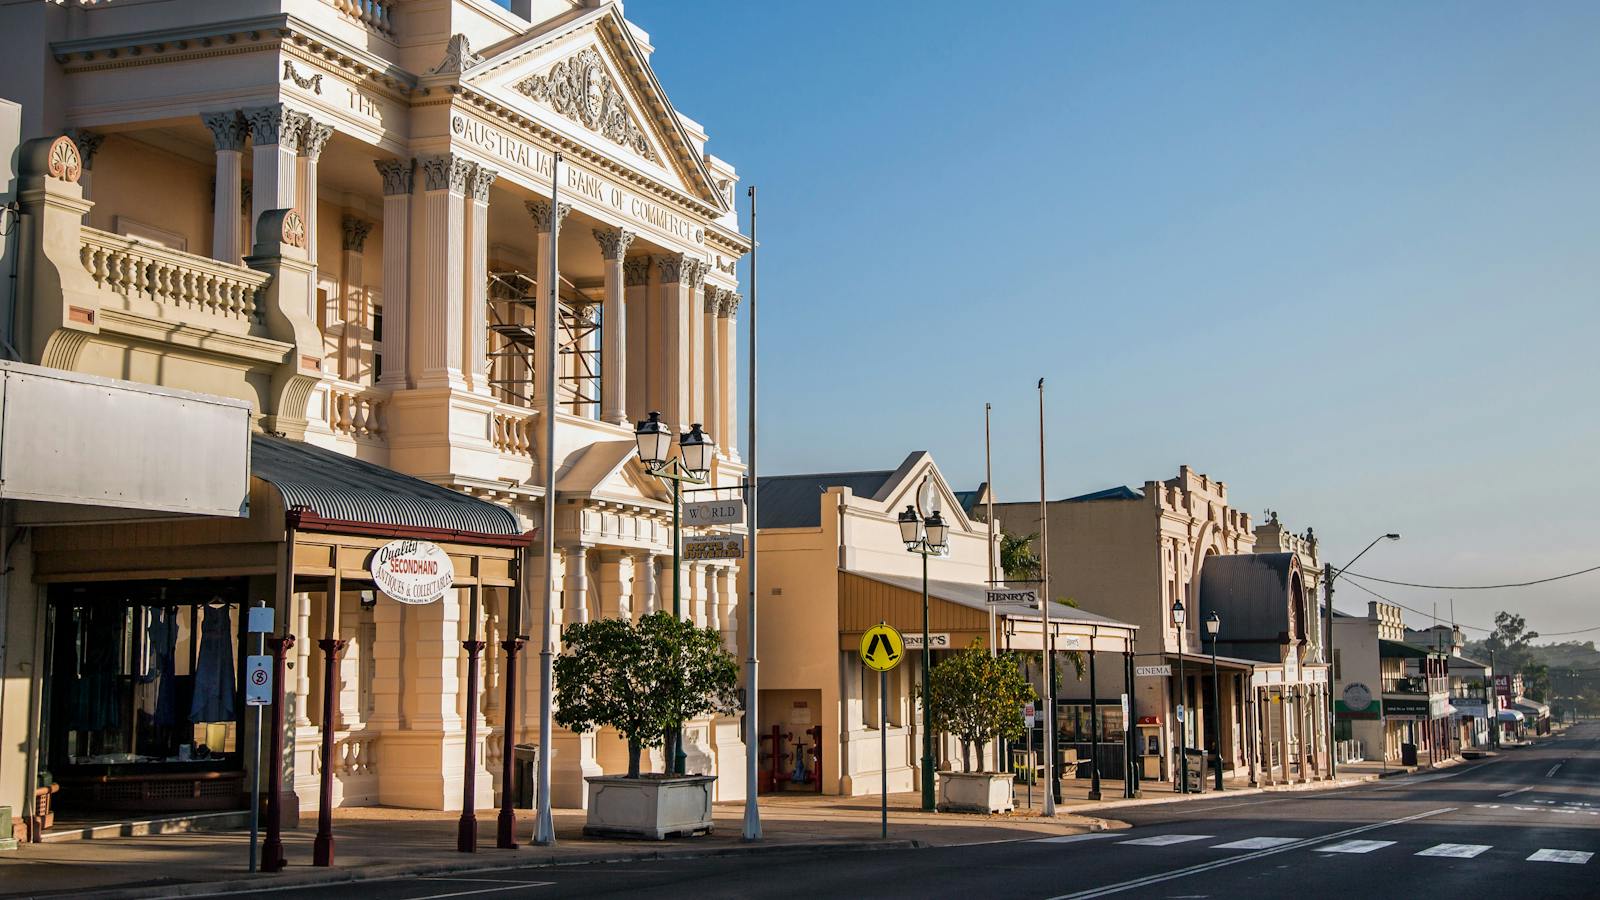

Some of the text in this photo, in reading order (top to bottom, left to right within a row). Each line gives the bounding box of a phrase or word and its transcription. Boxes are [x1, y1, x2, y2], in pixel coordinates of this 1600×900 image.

[568, 166, 604, 201] BANK
[611, 188, 625, 211] OF
[631, 198, 696, 242] COMMERCE
[689, 505, 736, 520] WORLD
[380, 541, 418, 565] Quality
[390, 558, 438, 575] SECONDHAND
[378, 566, 452, 598] ANTIQUES & COLLECTABLES
[987, 591, 1035, 602] HENRY'S
[1136, 667, 1169, 675] CINEMA
